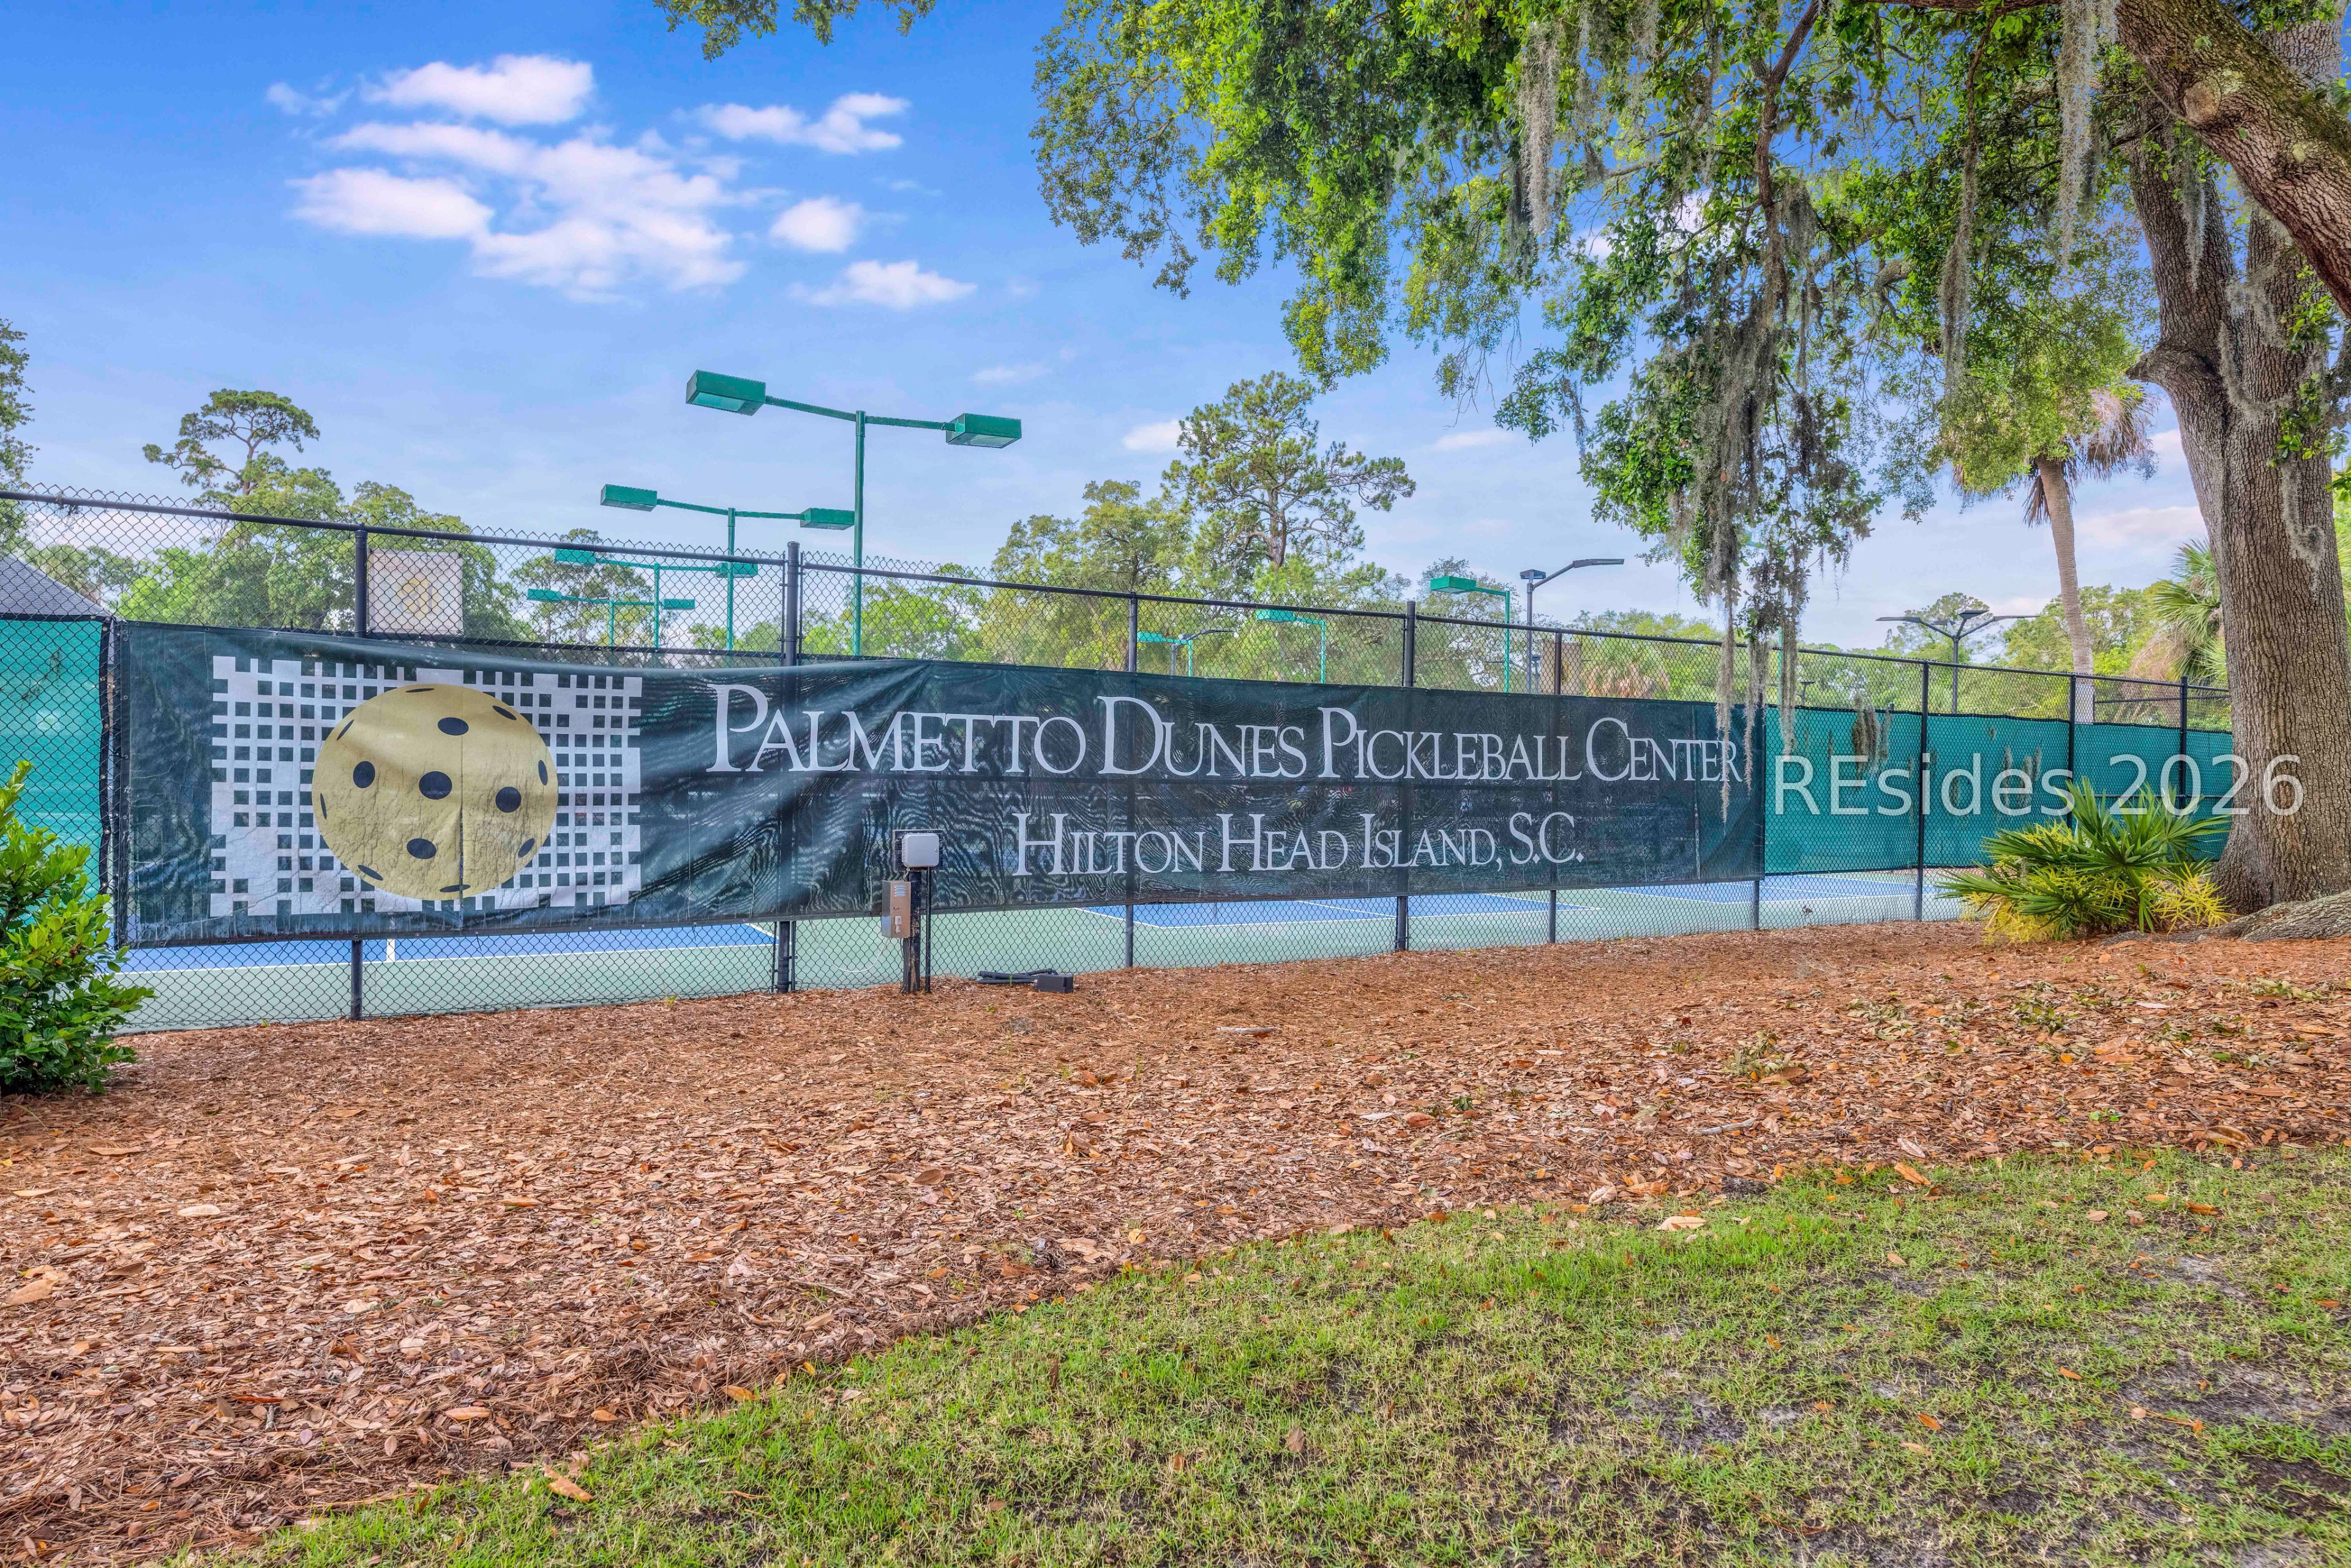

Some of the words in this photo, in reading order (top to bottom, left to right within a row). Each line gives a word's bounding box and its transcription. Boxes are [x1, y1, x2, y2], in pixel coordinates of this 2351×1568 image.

[706, 683, 1087, 774] PALMETTO
[1097, 696, 1307, 778] DUNES
[1318, 707, 1582, 781] PICKLEBALL
[1586, 717, 1743, 782] CENTER
[1012, 812, 1207, 876] HILTON
[1216, 812, 1348, 872] HEAD
[1360, 812, 1502, 872] ISLAND,
[1509, 811, 1584, 865] S.C.
